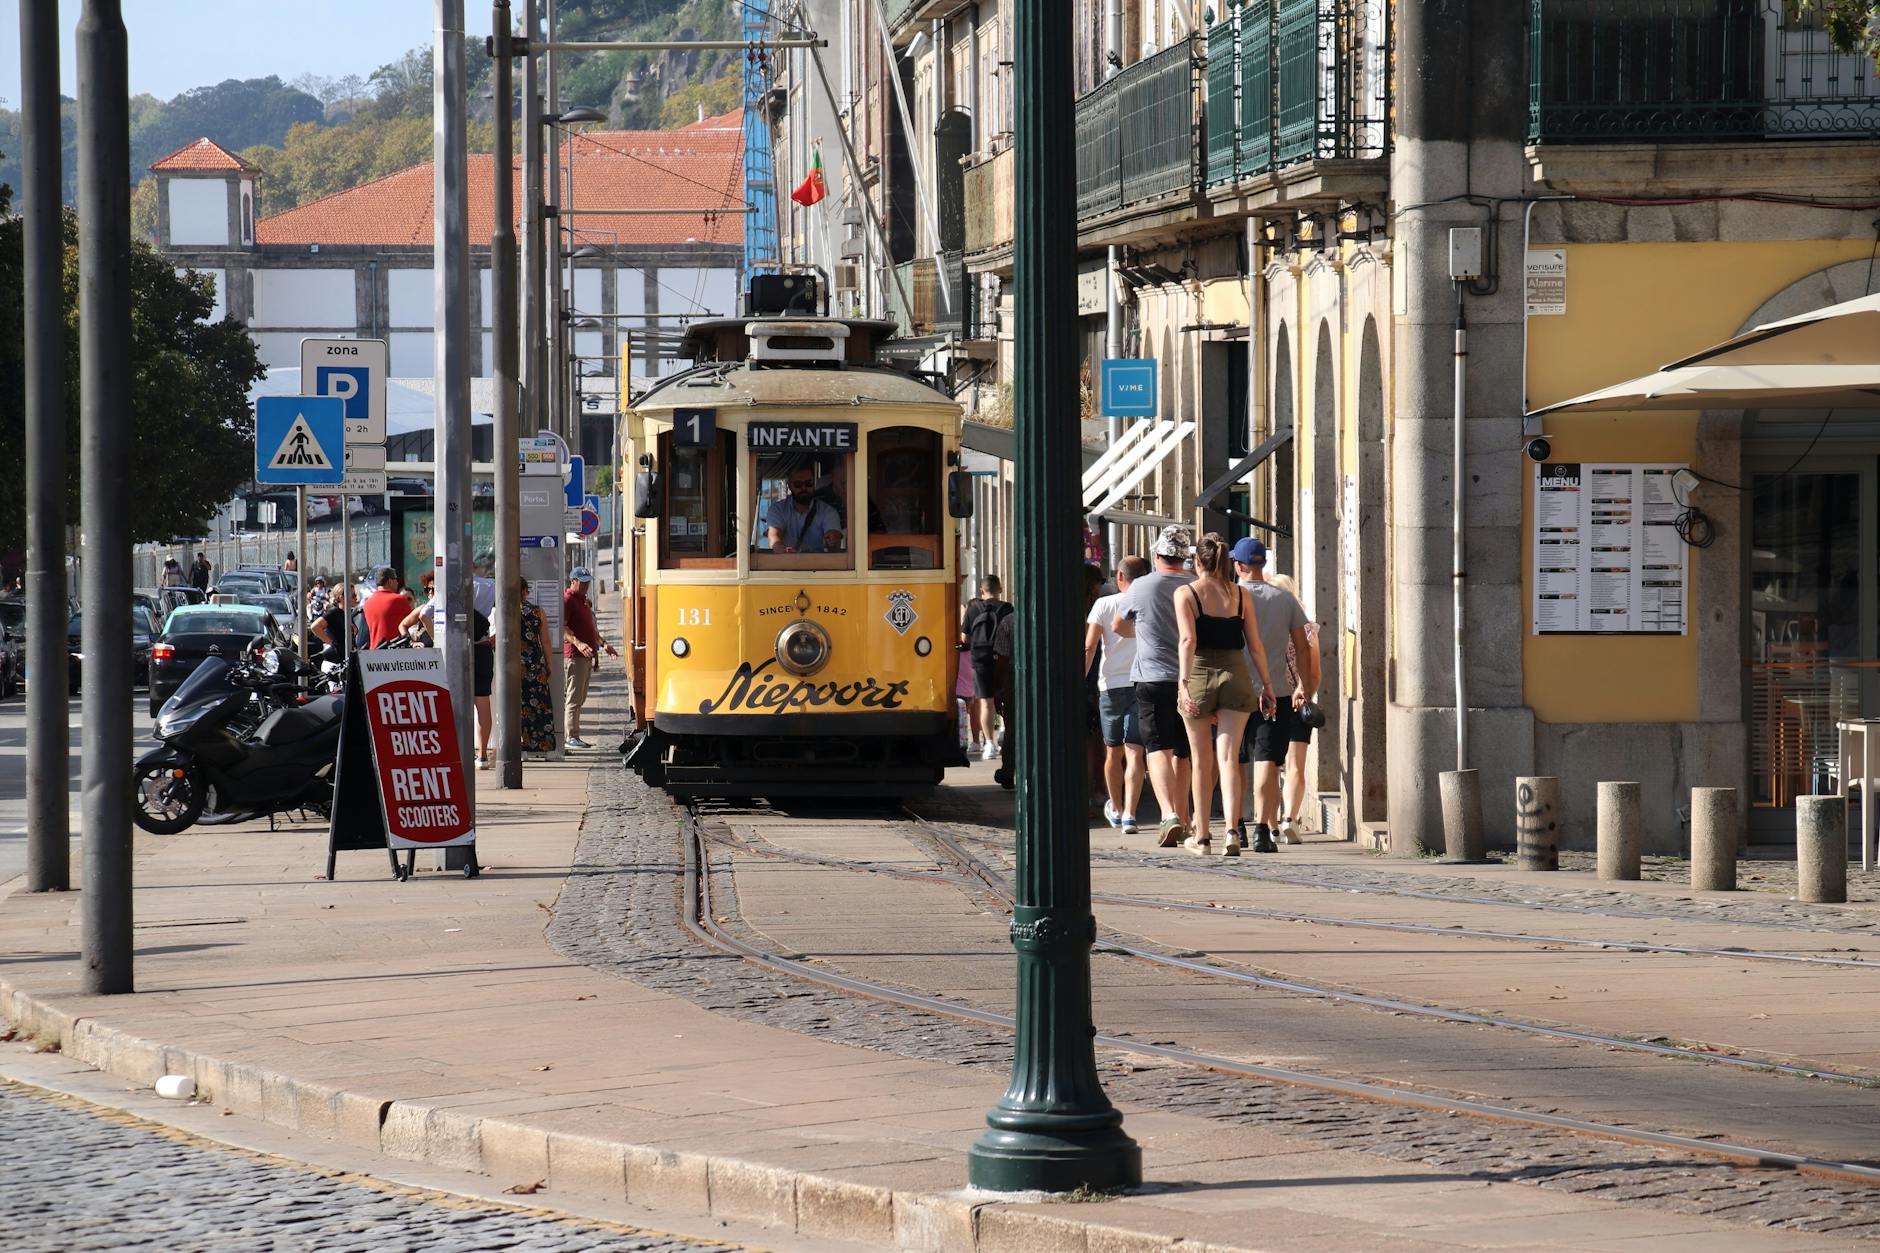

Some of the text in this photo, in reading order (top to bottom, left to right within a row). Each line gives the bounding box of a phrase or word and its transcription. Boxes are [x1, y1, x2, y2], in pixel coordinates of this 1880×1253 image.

[1527, 263, 1564, 271] verisure
[1527, 278, 1563, 288] Alarme
[327, 346, 358, 355] zona
[327, 373, 358, 400] P
[686, 414, 700, 443] 1
[753, 427, 850, 447] INFANTE
[1542, 477, 1579, 486] MENU
[523, 495, 545, 504] Porto.
[413, 522, 427, 534] 15
[678, 607, 712, 625] 131
[759, 605, 847, 616] SINCE 1842
[699, 657, 910, 714] Niepoort
[377, 690, 439, 725] RENT
[390, 730, 442, 756] BIKES
[390, 767, 452, 801] RENT
[397, 804, 460, 829] SCOOTERS
